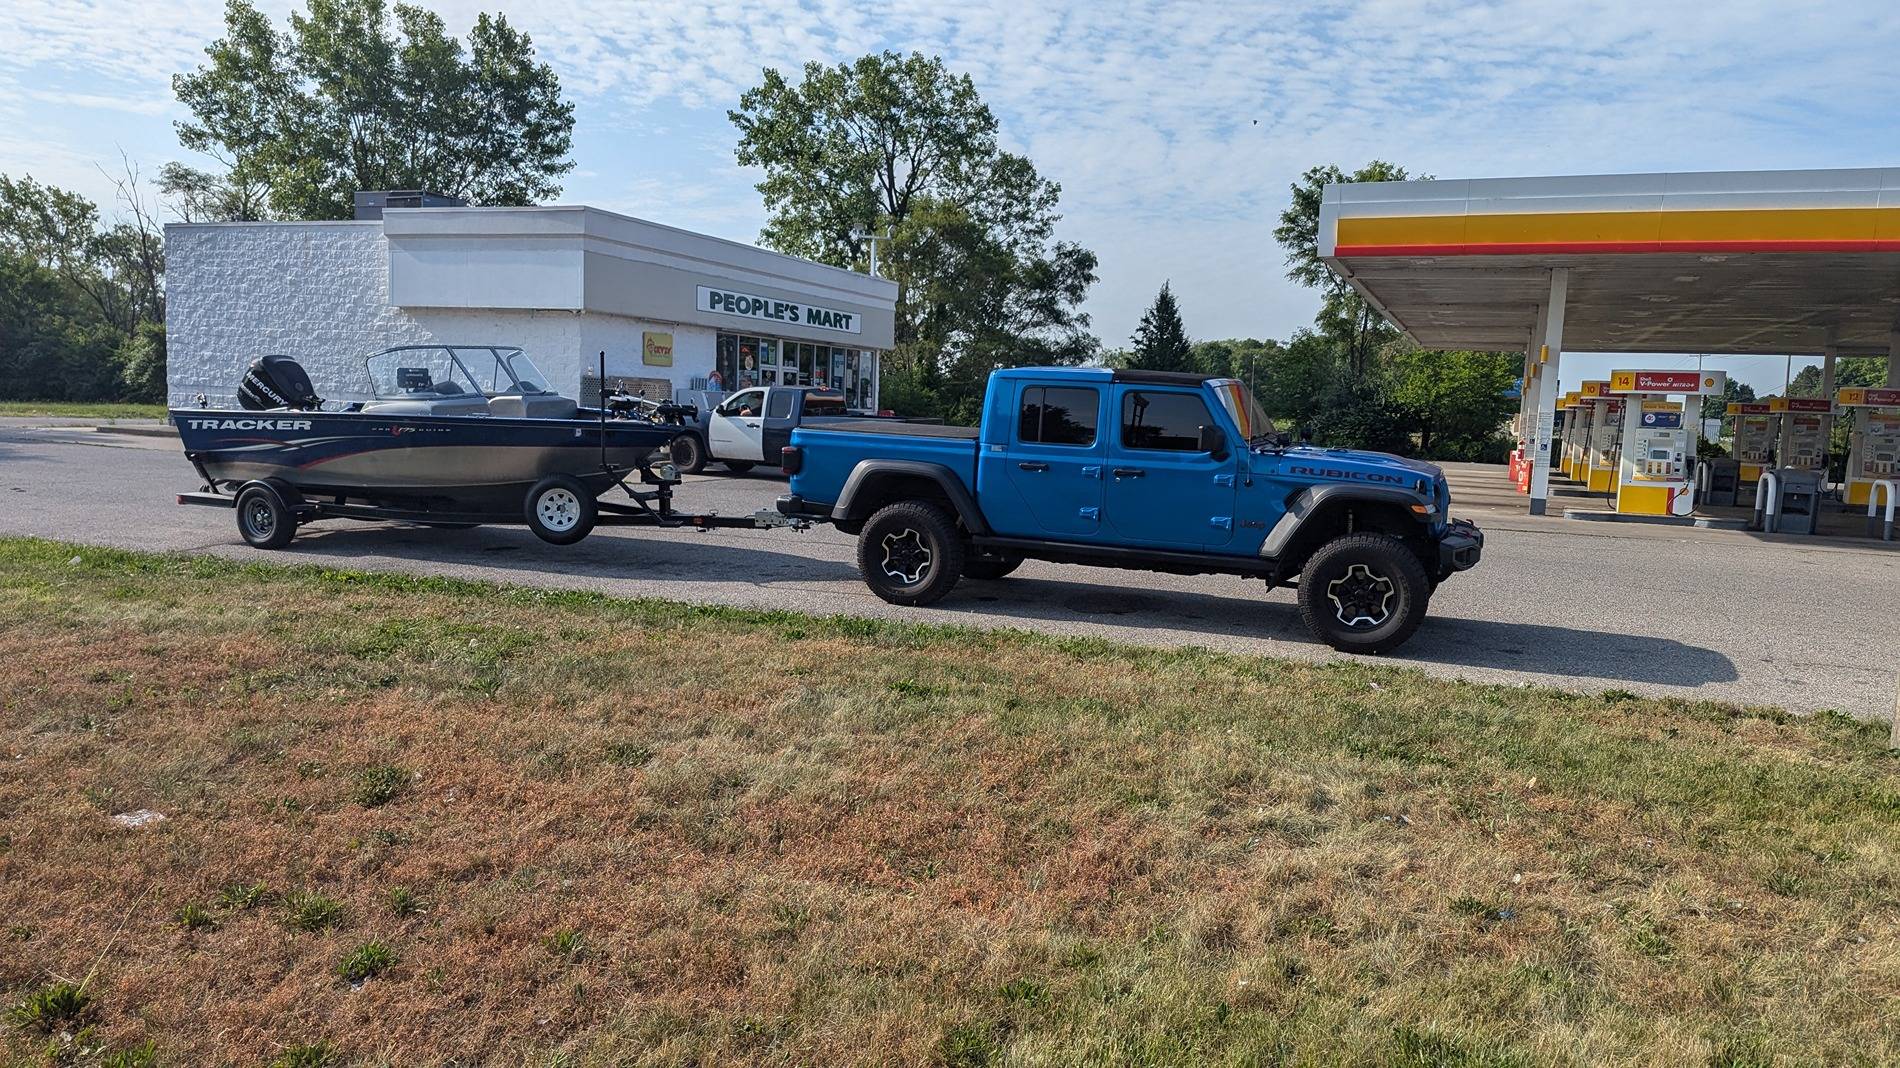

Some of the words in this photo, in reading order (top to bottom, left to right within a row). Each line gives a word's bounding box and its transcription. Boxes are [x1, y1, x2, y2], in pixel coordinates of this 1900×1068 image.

[709, 291, 800, 322] PEOPLE'S
[806, 307, 853, 330] MART
[246, 371, 289, 406] MERCURY
[1618, 376, 1630, 386] 14
[1586, 385, 1596, 394] 10
[187, 419, 313, 431] TRACKER
[1289, 466, 1404, 484] RUBICON
